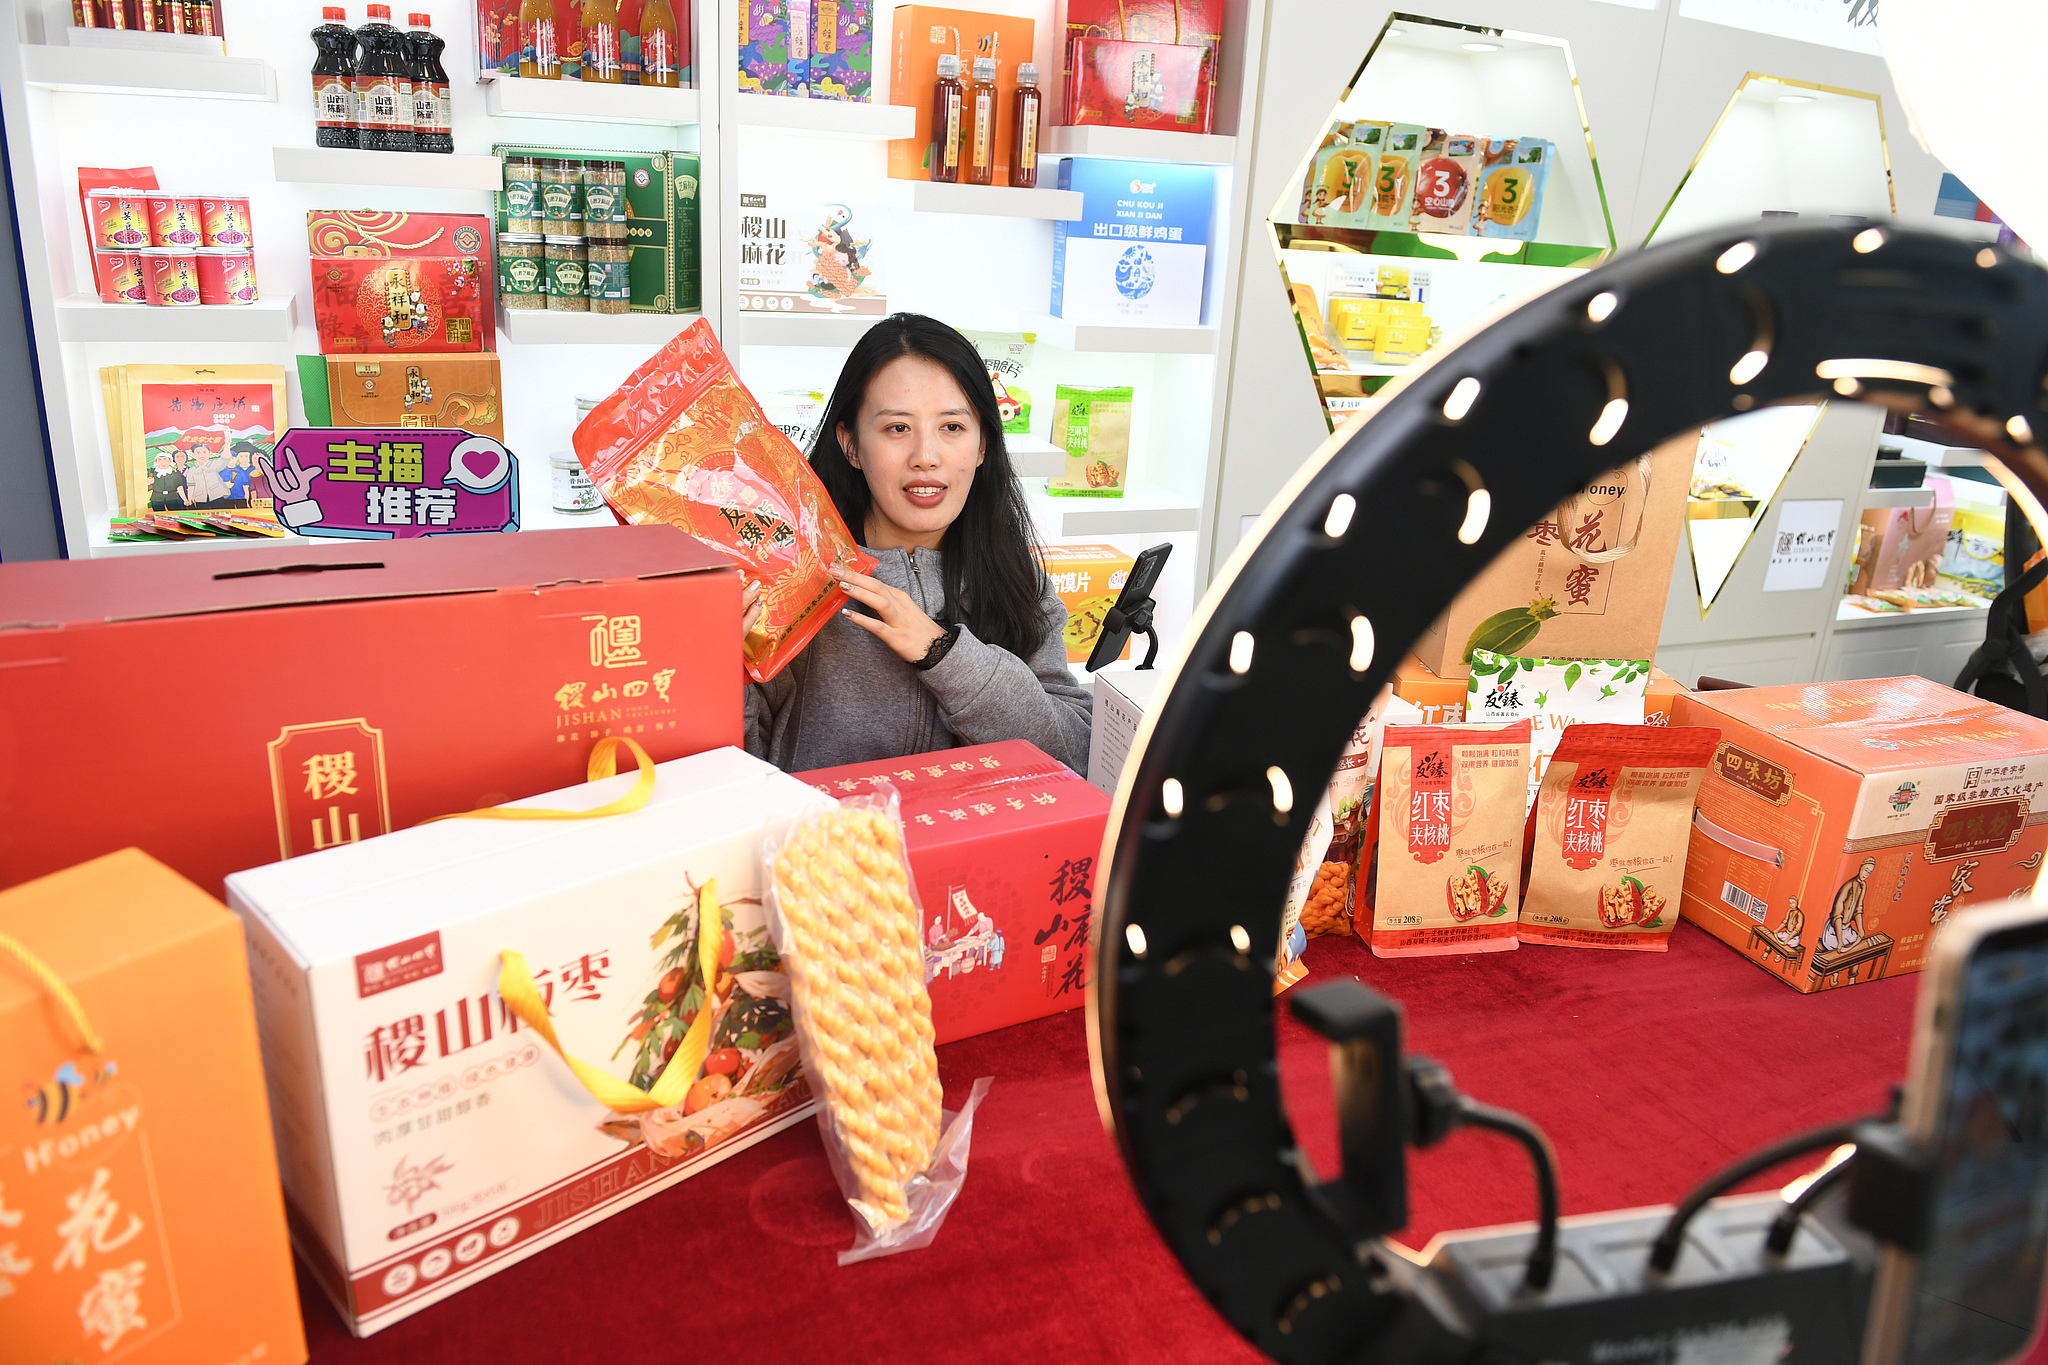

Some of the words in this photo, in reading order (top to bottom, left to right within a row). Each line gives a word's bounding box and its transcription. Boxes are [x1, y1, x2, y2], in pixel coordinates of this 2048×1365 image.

[326, 94, 344, 105] 山西
[374, 95, 393, 106] 山西
[1341, 161, 1357, 188] 3
[1379, 166, 1395, 192] 3
[1433, 170, 1450, 197] 3
[1502, 178, 1518, 203] 3
[1116, 210, 1135, 218] XIAN
[1145, 211, 1162, 219] DAN
[1117, 200, 1135, 208] CHU
[1137, 201, 1155, 209] KOU
[741, 216, 786, 239] 稷山
[1093, 222, 1183, 241] 出口级鲜鸡蛋
[741, 242, 787, 265] 麻花
[389, 273, 408, 325] 永祥和
[327, 440, 424, 483] 主播
[366, 486, 457, 526] 推荐
[718, 499, 766, 550] 友臻
[752, 499, 795, 548] 板枣
[1527, 520, 1560, 547] 枣
[556, 708, 622, 729] JISHAN
[1461, 750, 1489, 758] 颗颗饱满
[1491, 749, 1519, 757] 粒粒精选
[1461, 760, 1488, 768] 双重营养
[1491, 759, 1519, 768] 健康加倍
[1630, 771, 1660, 779] 颗颗饱满
[1662, 771, 1690, 779] 粒粒精选
[1726, 752, 1782, 791] 四味坊
[1983, 764, 2026, 777] 中华老字号
[302, 751, 360, 851] 稷山
[1411, 789, 1450, 822] 红枣
[1933, 781, 2044, 806] 国家级非物质文化遗产
[1566, 797, 1608, 830] 红枣
[1410, 824, 1450, 847] 夹核桃
[1563, 830, 1604, 853] 夹核桃
[23, 1104, 140, 1175] Honey
